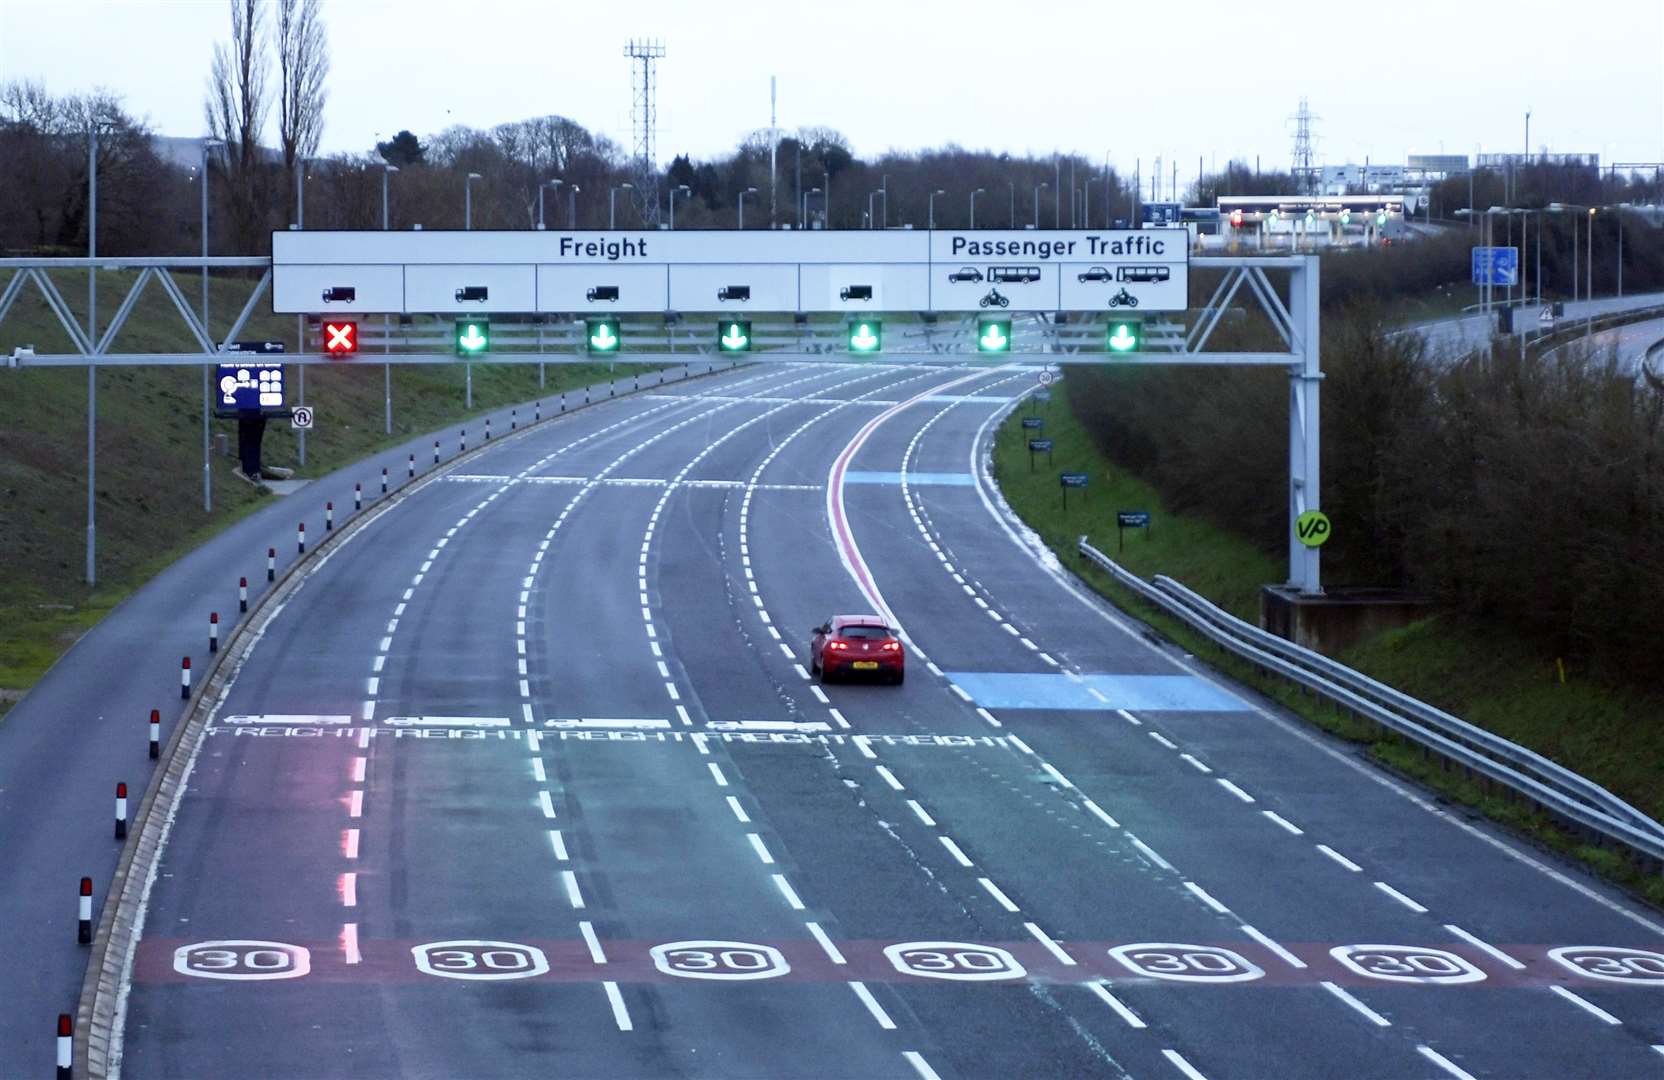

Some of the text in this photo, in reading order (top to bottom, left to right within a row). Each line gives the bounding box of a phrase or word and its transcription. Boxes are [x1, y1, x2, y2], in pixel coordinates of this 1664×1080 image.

[560, 238, 647, 260] Freight
[952, 236, 1165, 259] Passenger Traffic
[205, 726, 360, 737] FREIGHT
[370, 728, 526, 740] FREIGHT
[536, 730, 691, 742] FREIGHT
[697, 732, 849, 745] FREIGHT
[861, 734, 1010, 748] FREIGHT
[193, 950, 289, 969] 30
[431, 950, 529, 969] 30
[669, 950, 768, 969] 30
[904, 951, 1004, 970] 30
[1134, 953, 1236, 972] 30
[1354, 954, 1462, 973] 30
[1573, 956, 1664, 975] 30
